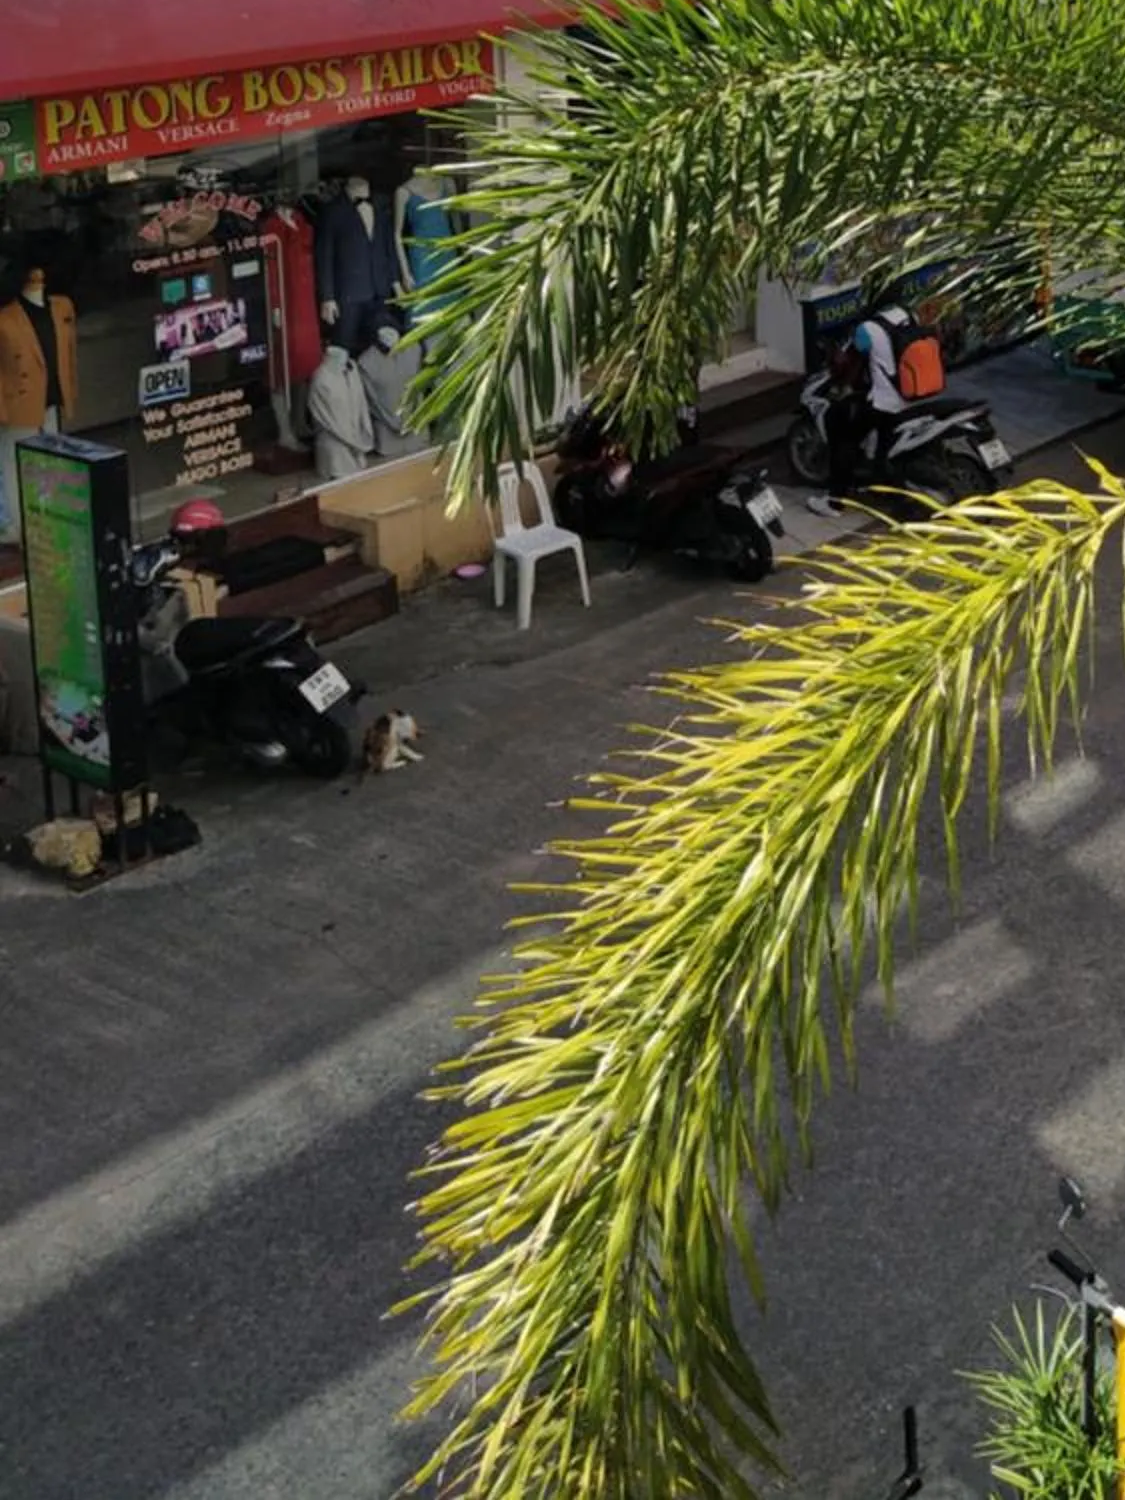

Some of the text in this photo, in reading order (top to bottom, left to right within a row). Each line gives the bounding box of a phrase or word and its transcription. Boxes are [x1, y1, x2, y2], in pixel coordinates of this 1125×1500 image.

[44, 39, 482, 145] PATONG BOSS TAILOR
[47, 134, 129, 164] ARMANI
[156, 117, 242, 145] VERSACE
[264, 107, 312, 128] Zegna
[335, 97, 372, 115] TOM
[145, 367, 185, 392] OPEN
[143, 409, 167, 425] We
